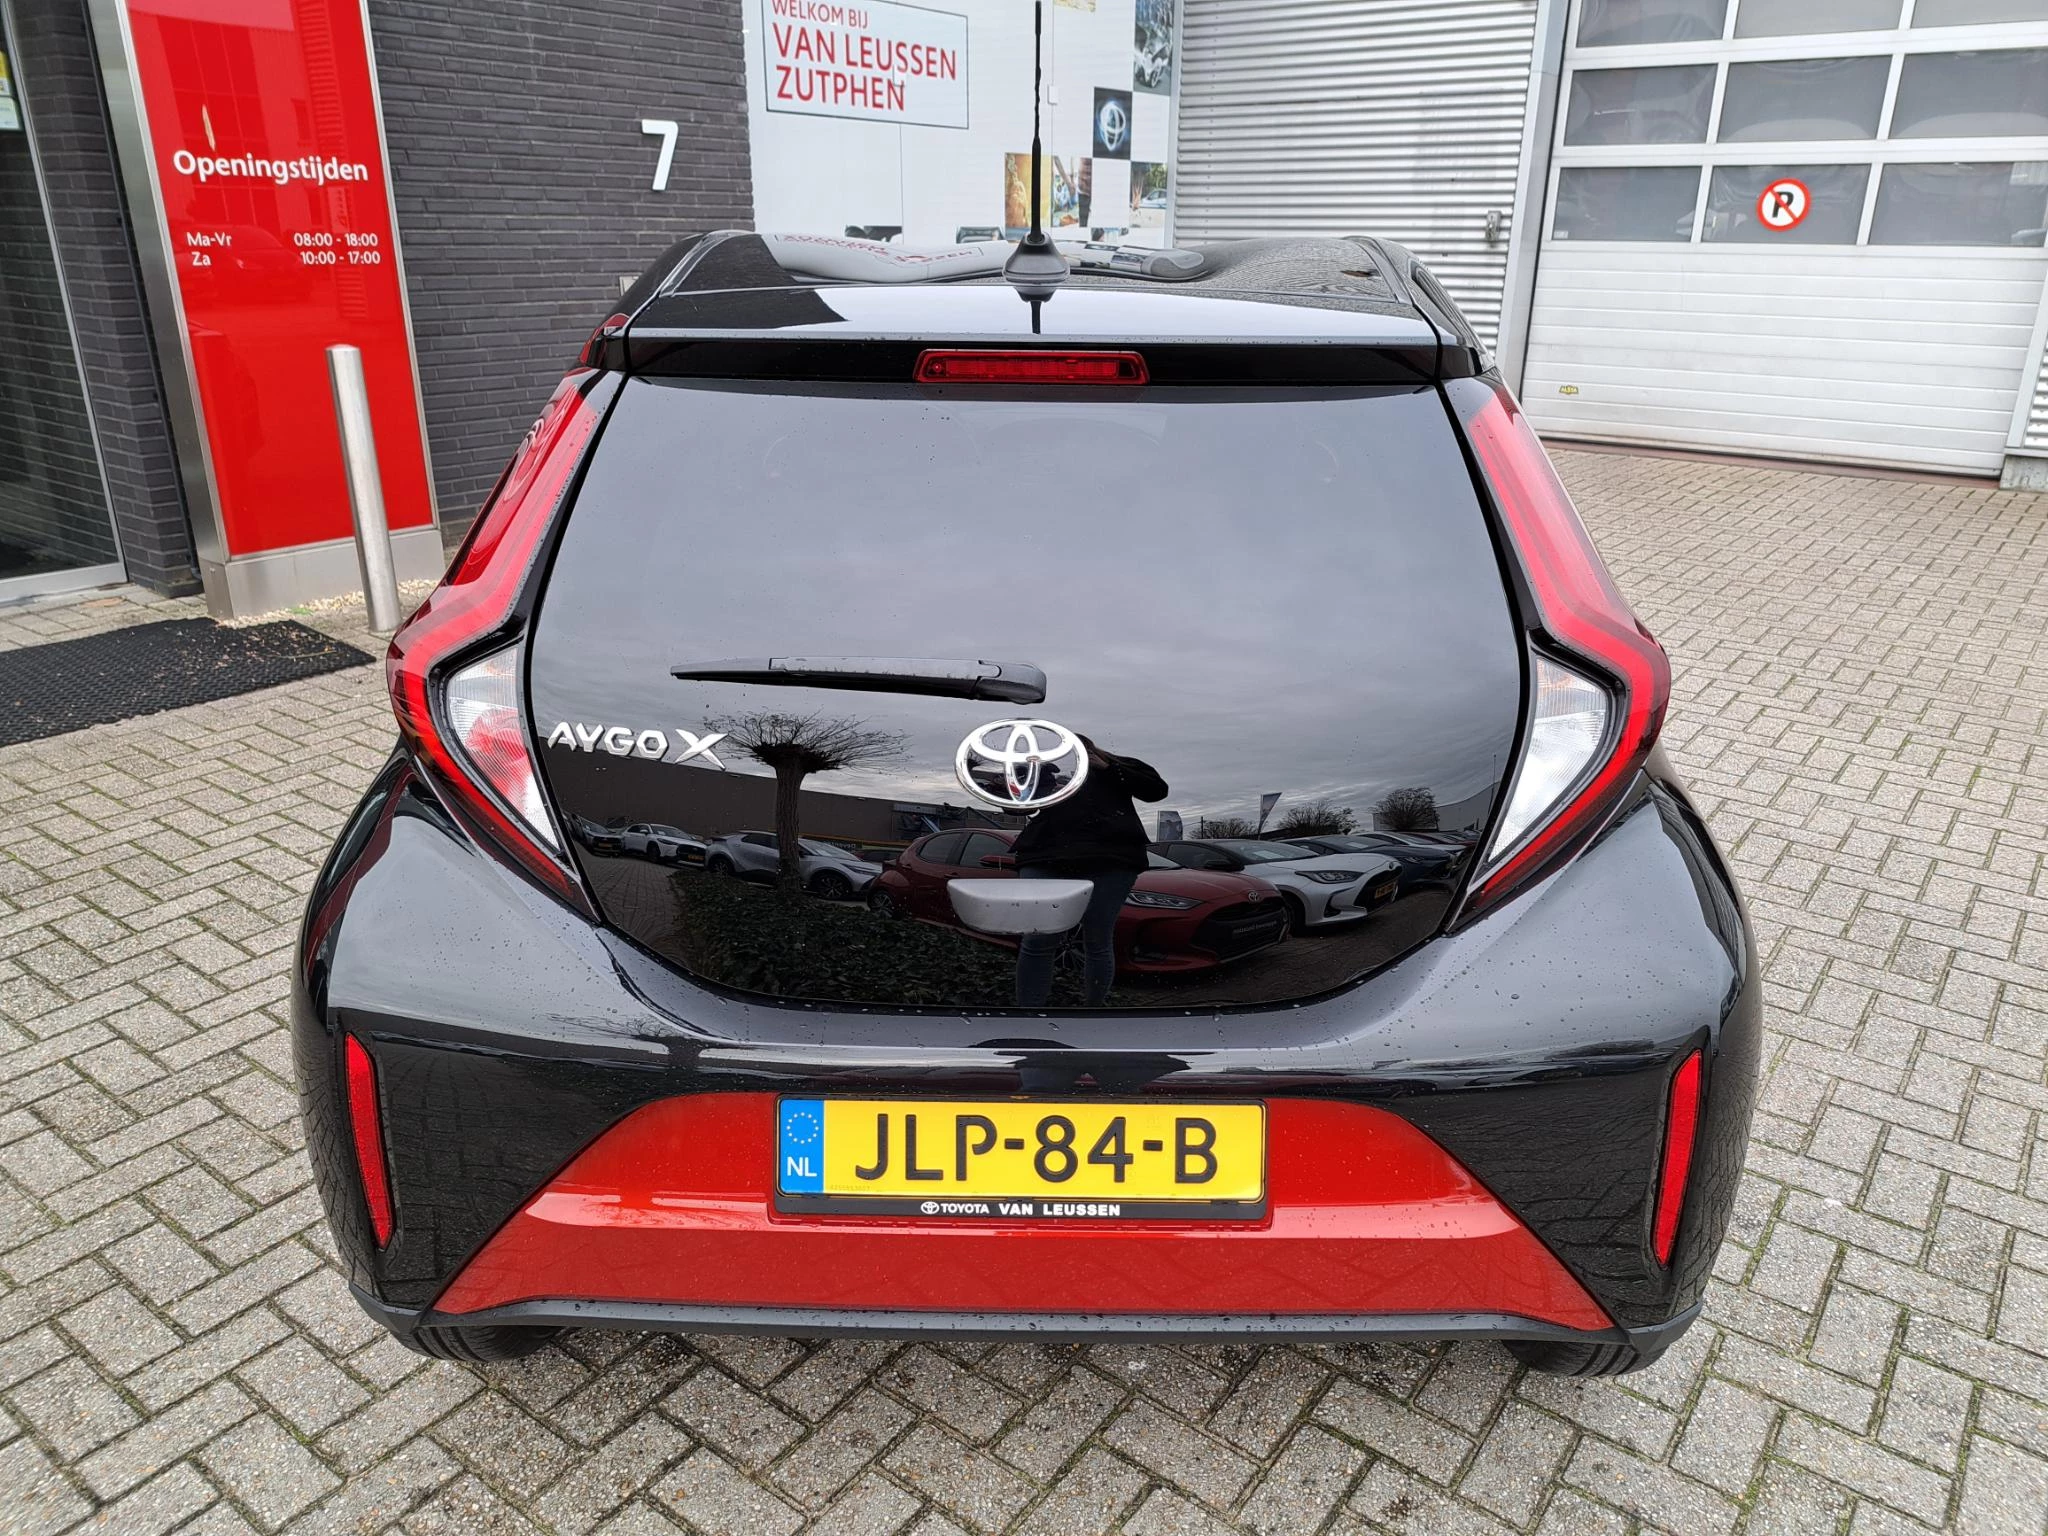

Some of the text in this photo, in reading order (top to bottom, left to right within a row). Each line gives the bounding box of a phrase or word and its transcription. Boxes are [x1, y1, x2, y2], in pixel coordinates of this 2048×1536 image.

[771, 0, 869, 29] WELKOM BIJ
[772, 22, 956, 81] VAN LEUSSEN
[776, 64, 905, 111] ZUTPHEN
[173, 150, 369, 186] Openingstijden
[641, 119, 679, 191] 7
[186, 232, 232, 247] Ma-Vr
[293, 233, 333, 247] 08:00
[345, 233, 378, 247] 18:00
[192, 251, 212, 266] Za
[300, 251, 336, 265] 10:00
[348, 251, 381, 265] 17:00
[548, 722, 729, 771] AYGO X
[855, 1112, 1218, 1184] JLP-84-B
[786, 1156, 817, 1177] NL
[940, 1203, 1121, 1217] TOYOTA VAN LEUSSEN
